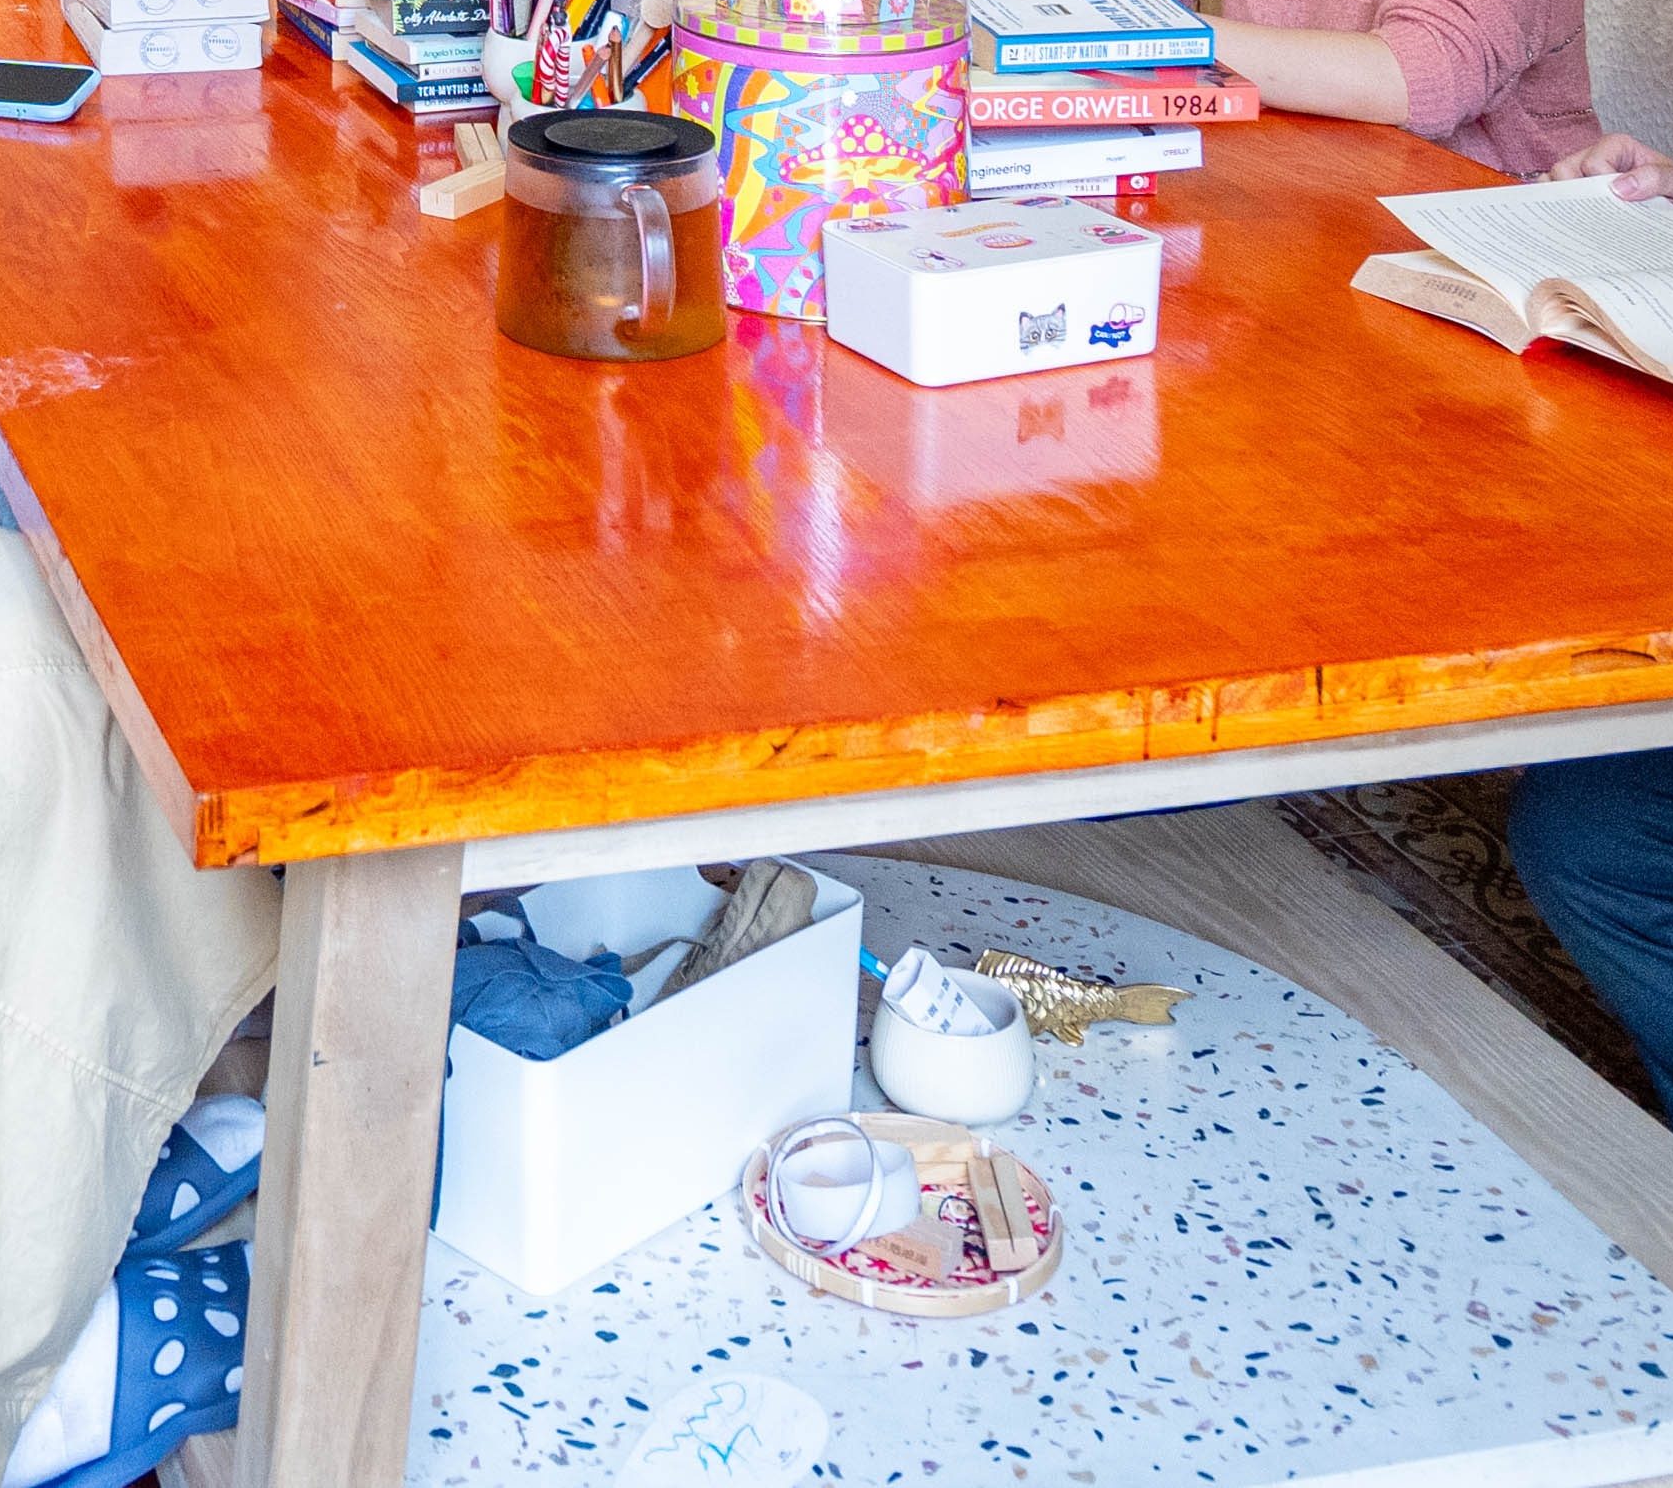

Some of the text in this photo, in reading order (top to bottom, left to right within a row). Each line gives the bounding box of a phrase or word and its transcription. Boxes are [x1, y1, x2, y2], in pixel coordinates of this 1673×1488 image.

[403, 9, 424, 27] My
[423, 10, 469, 25] Absolute
[423, 49, 448, 59] Angela
[454, 48, 474, 56] Davis
[1039, 43, 1108, 61] START-UP NATION
[417, 86, 436, 97] TEN
[438, 84, 470, 96] MYTHS
[1051, 95, 1153, 120] ORWELL
[1162, 95, 1219, 117] 1984
[971, 163, 1032, 180] ngineering
[1163, 147, 1191, 157] O'REILLY
